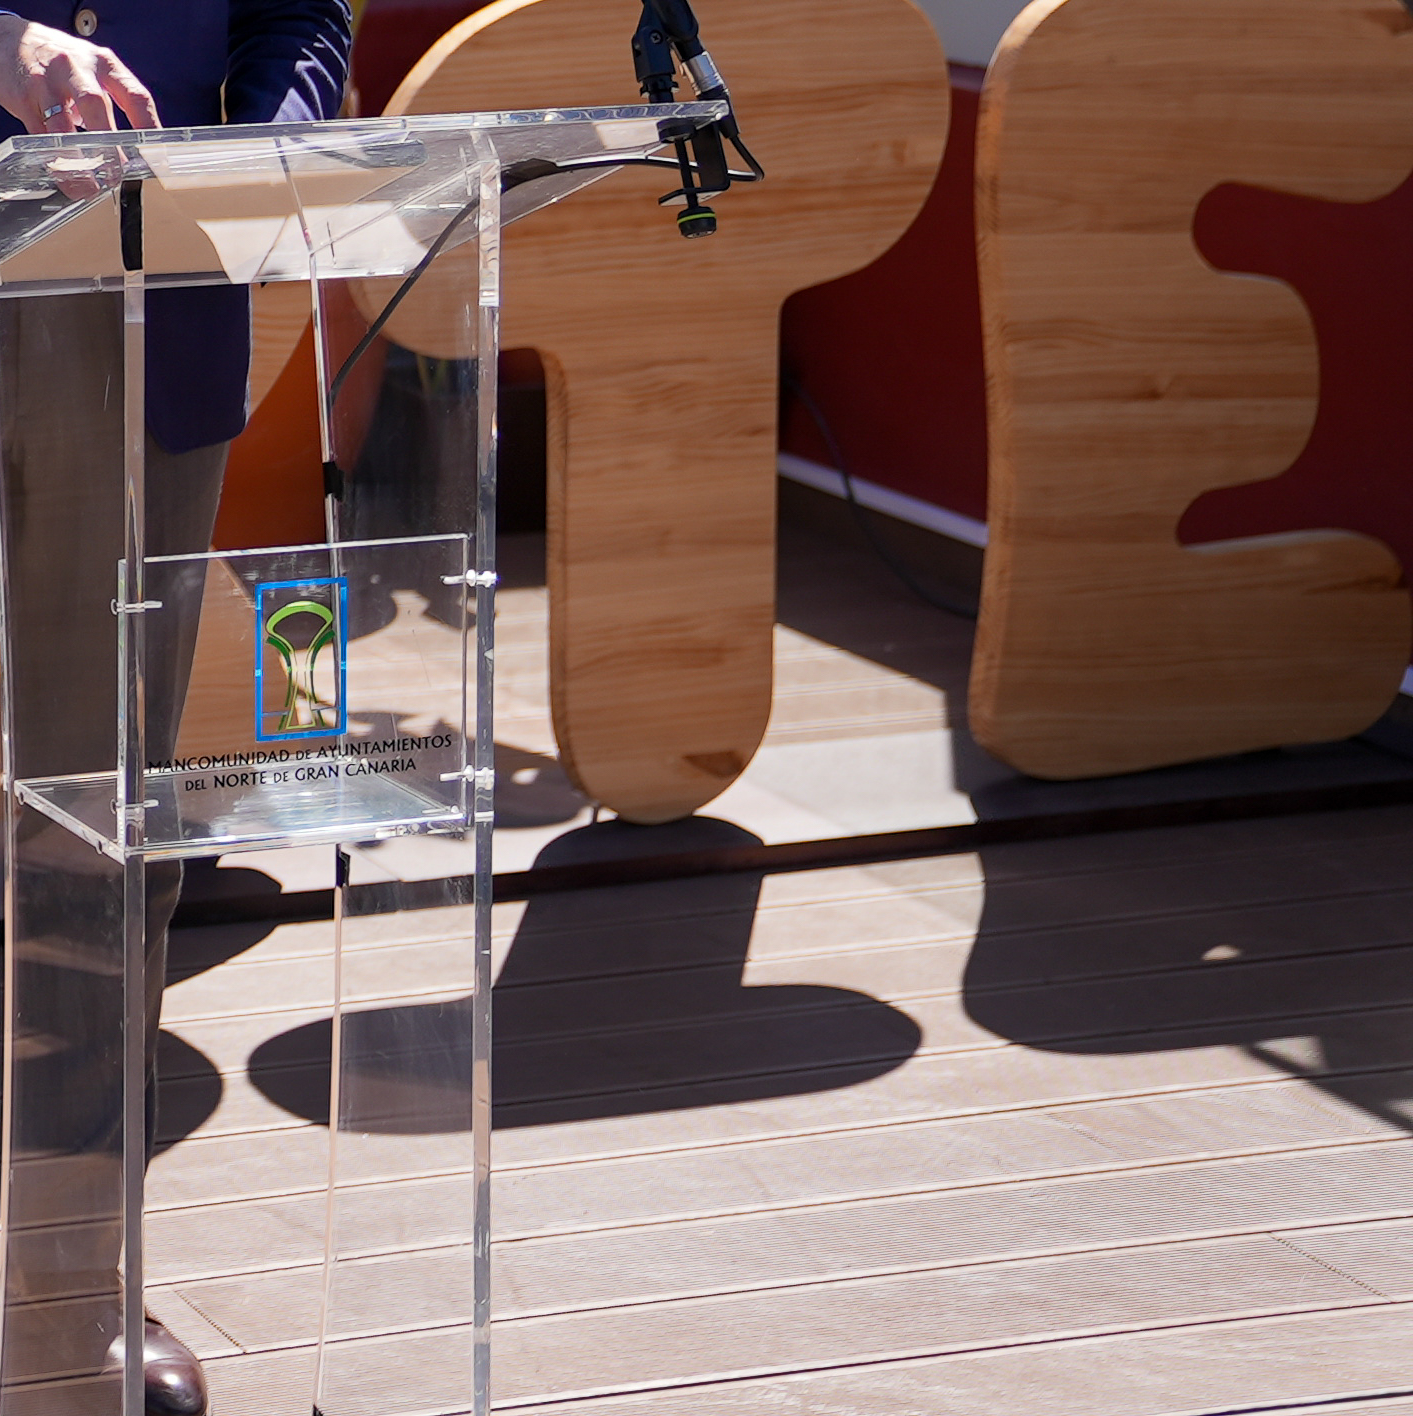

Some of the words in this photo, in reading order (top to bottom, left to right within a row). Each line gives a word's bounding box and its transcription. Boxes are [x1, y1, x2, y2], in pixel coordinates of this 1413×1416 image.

[148, 750, 290, 774] MANCOMUNIDAD
[295, 748, 313, 761] DE
[316, 734, 453, 759] AYUNTAMIENTOS
[184, 778, 208, 792] DEL
[213, 771, 267, 789] NORTE
[273, 770, 290, 783] DE
[295, 764, 340, 782] GRAN
[344, 758, 417, 777] CANARIA
